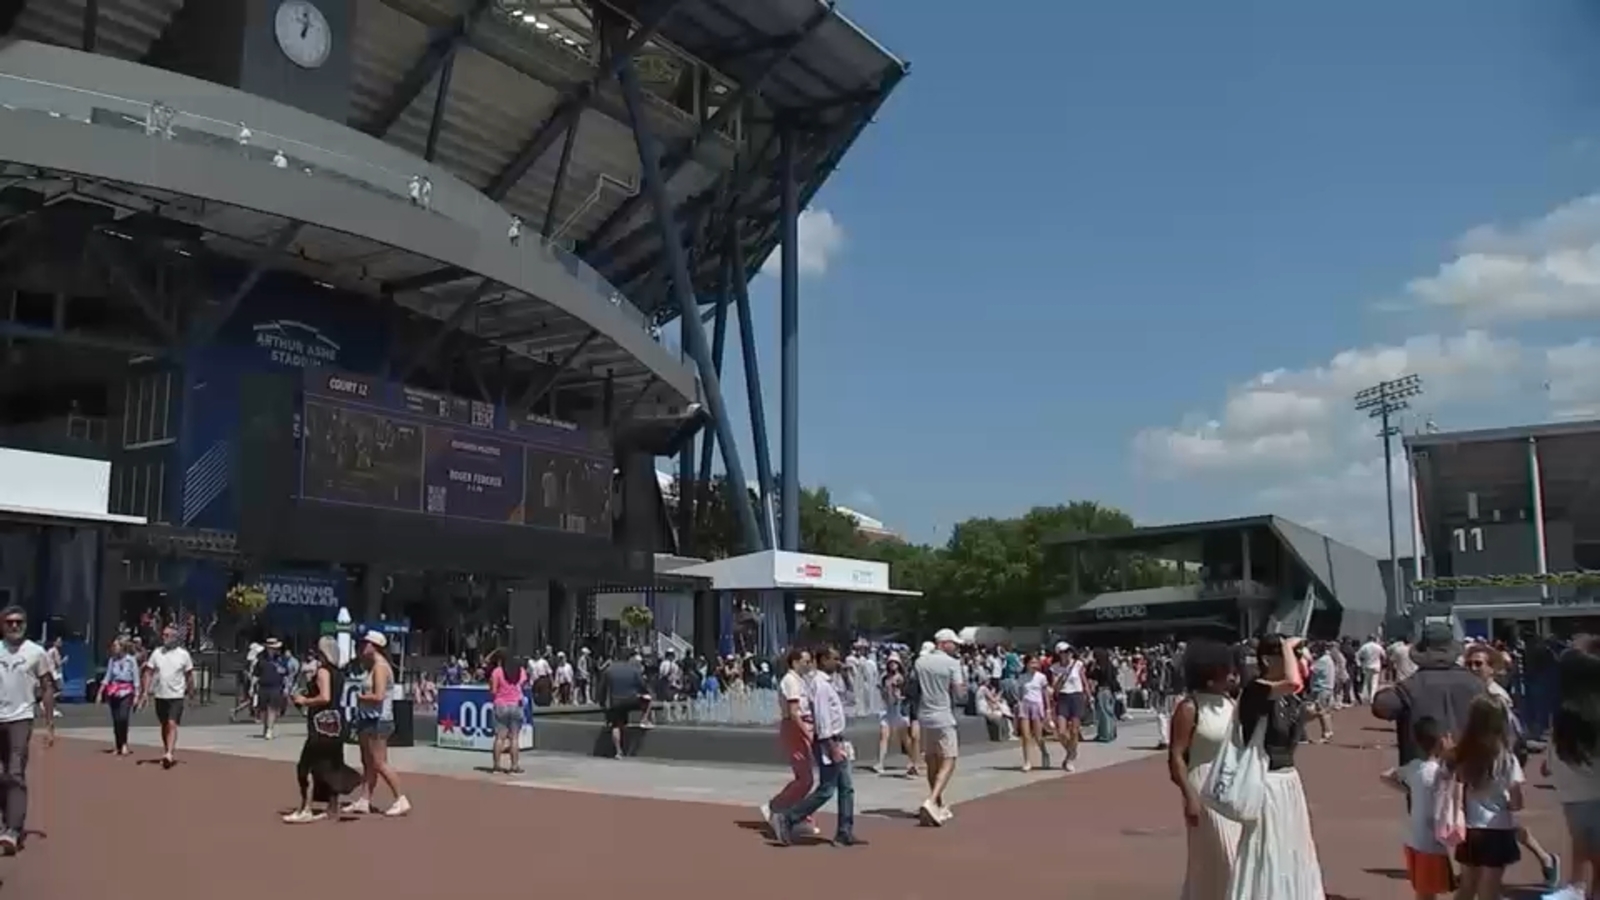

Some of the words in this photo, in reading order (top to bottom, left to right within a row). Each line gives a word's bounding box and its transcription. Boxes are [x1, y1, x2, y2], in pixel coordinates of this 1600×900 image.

[256, 332, 304, 354] ARTHUR
[306, 344, 337, 361] ASHE
[329, 377, 357, 394] COURT
[1453, 527, 1484, 552] 11
